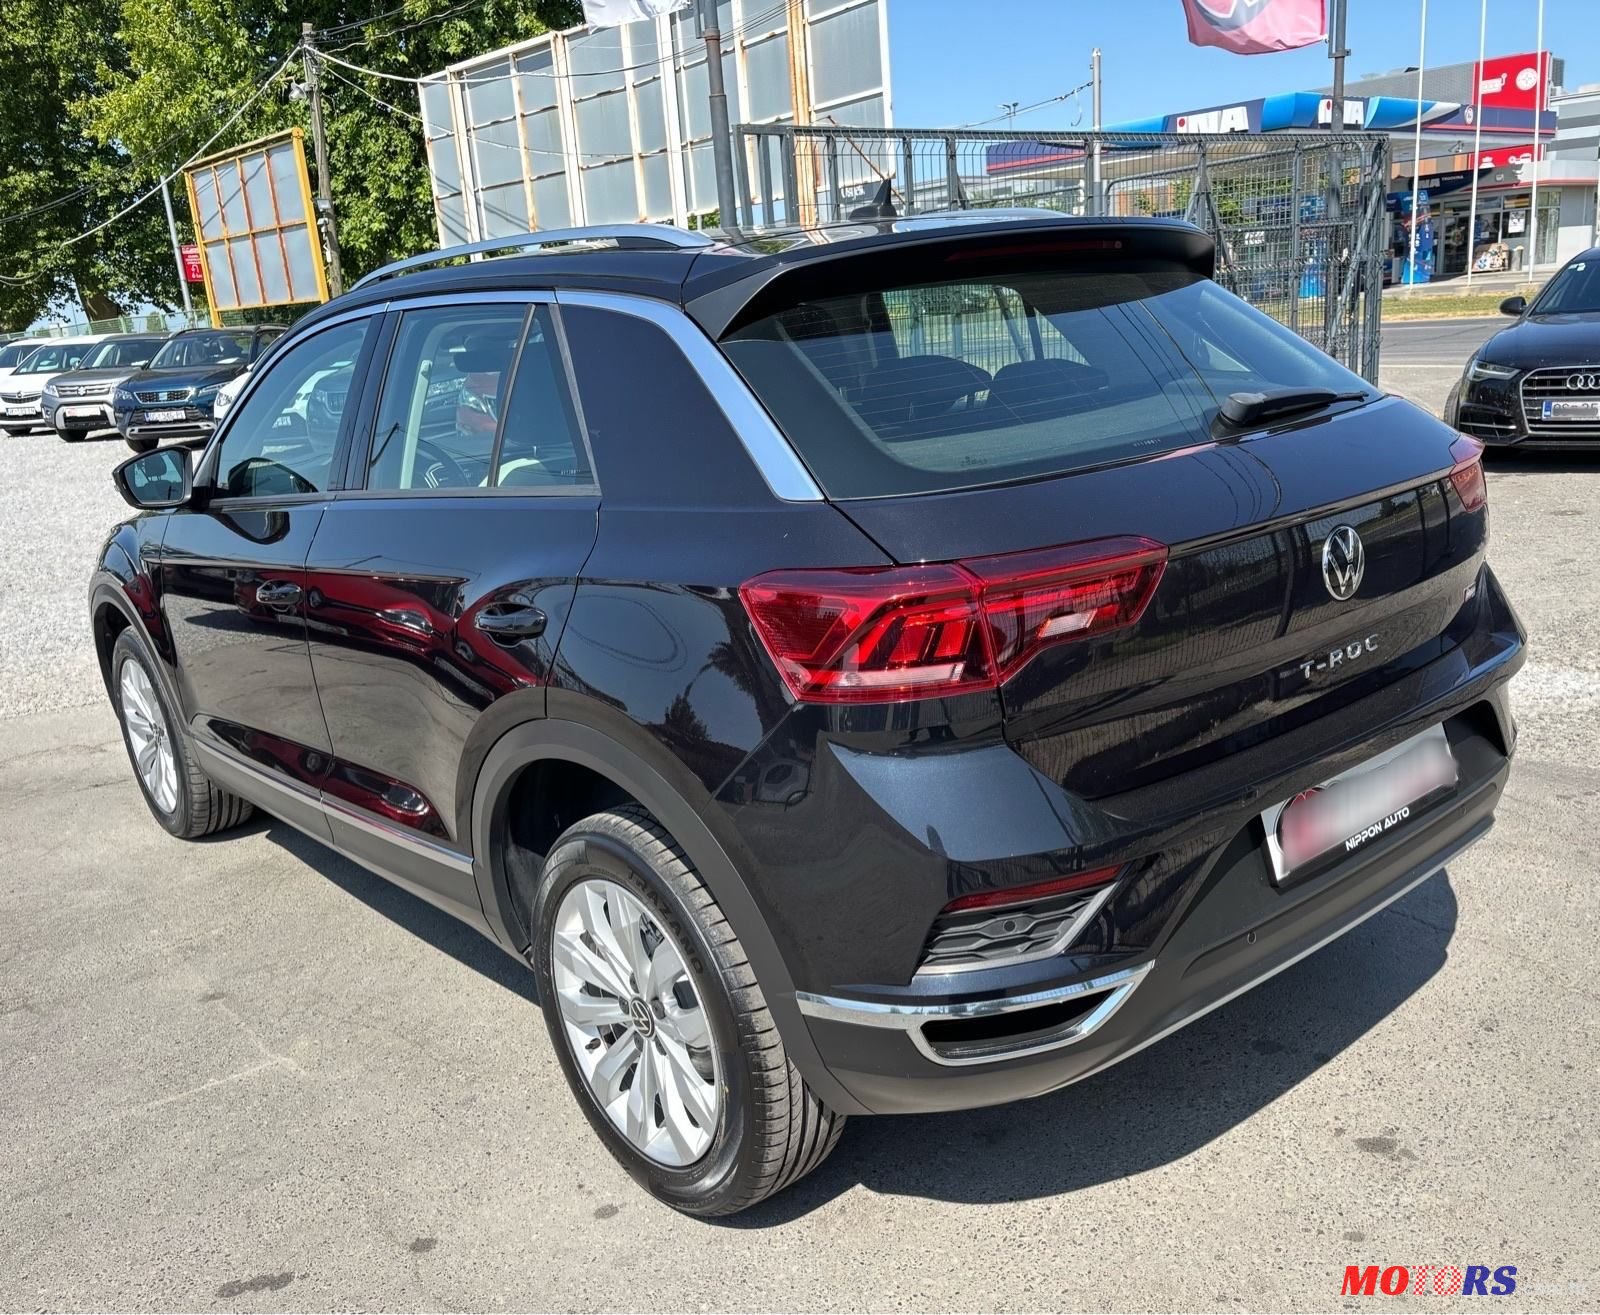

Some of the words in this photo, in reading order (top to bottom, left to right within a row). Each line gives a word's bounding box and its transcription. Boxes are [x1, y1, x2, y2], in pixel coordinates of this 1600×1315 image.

[1299, 633, 1380, 679] T-ROC
[1345, 821, 1383, 851] NIPPON
[1384, 806, 1410, 830] AUTO
[626, 867, 705, 974] TRAZANO
